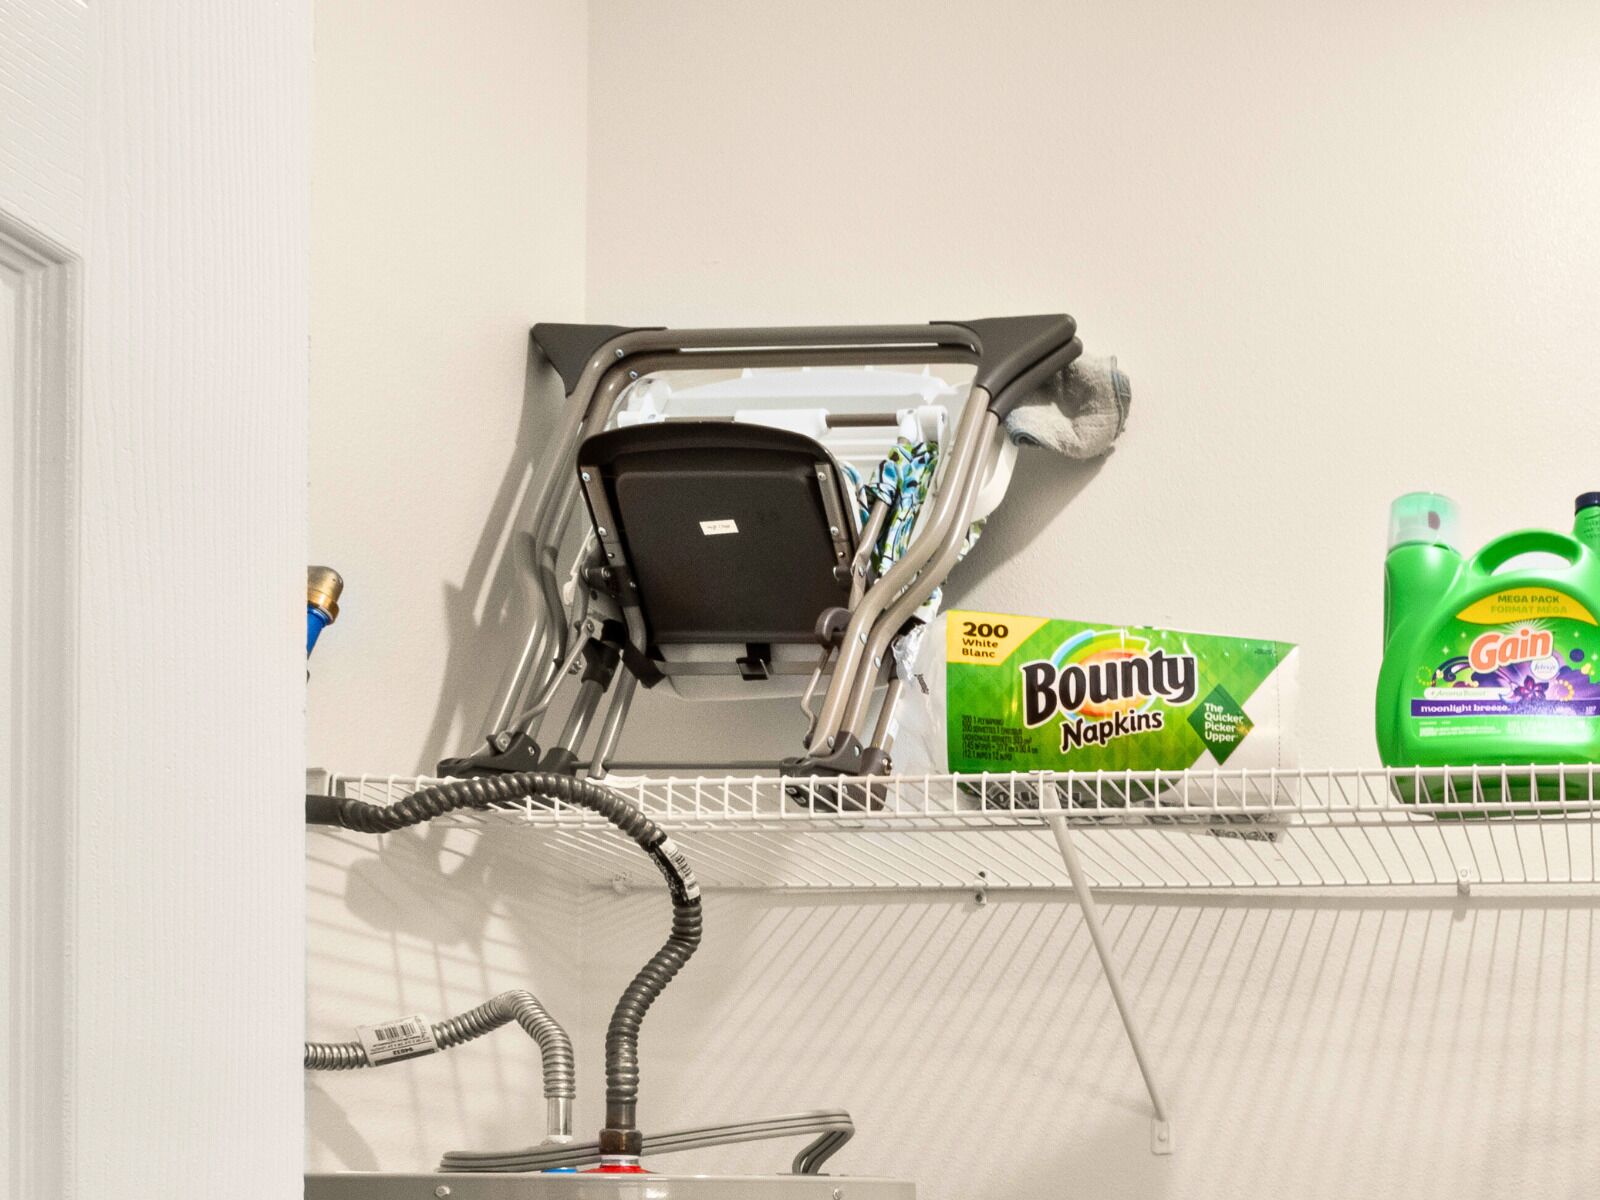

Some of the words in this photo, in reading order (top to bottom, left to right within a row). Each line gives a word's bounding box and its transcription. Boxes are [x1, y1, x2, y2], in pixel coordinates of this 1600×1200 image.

[1497, 595, 1528, 603] MEGA
[1531, 595, 1560, 603] PACK
[1490, 606, 1533, 614] FORMAT
[962, 622, 1009, 639] 200
[962, 638, 999, 649] White
[961, 648, 996, 658] Blanc
[1470, 629, 1552, 671] Gain
[1024, 651, 1195, 725] Bounty
[1205, 703, 1224, 713] The
[1421, 704, 1472, 714] moonlight
[1204, 712, 1244, 724] Quicker
[1061, 711, 1163, 751] Napkins
[1204, 722, 1236, 733] Picker
[1205, 732, 1236, 743] Upper
